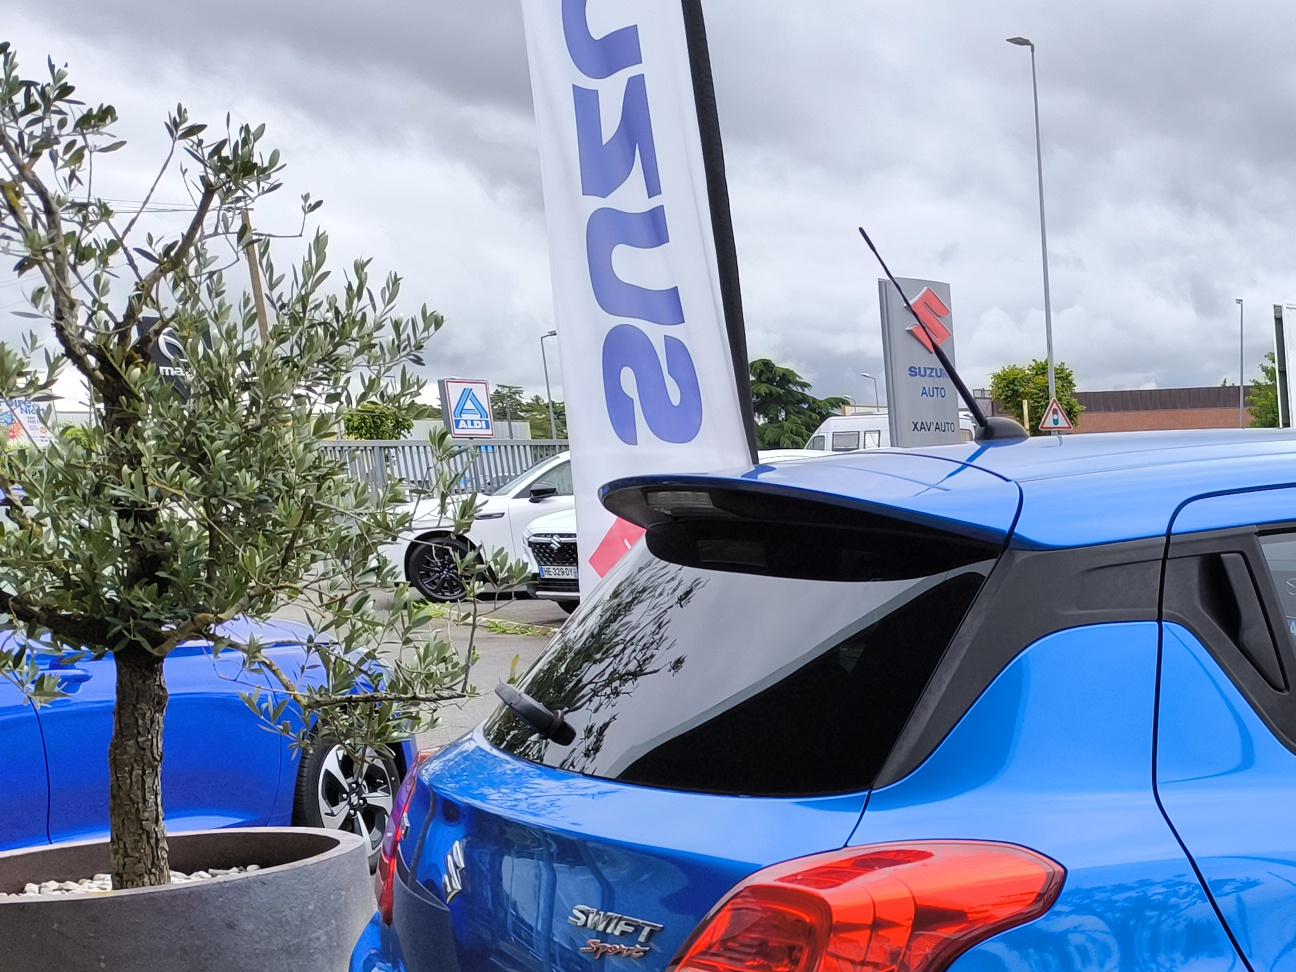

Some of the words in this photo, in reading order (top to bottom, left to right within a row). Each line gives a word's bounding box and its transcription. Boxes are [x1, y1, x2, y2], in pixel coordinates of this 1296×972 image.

[908, 366, 951, 379] SUZU
[921, 387, 946, 398] AUTO
[458, 420, 487, 429] ALDI
[912, 421, 956, 432] XAV'AUTO
[568, 904, 664, 943] SWIFT
[579, 938, 650, 960] Sport
